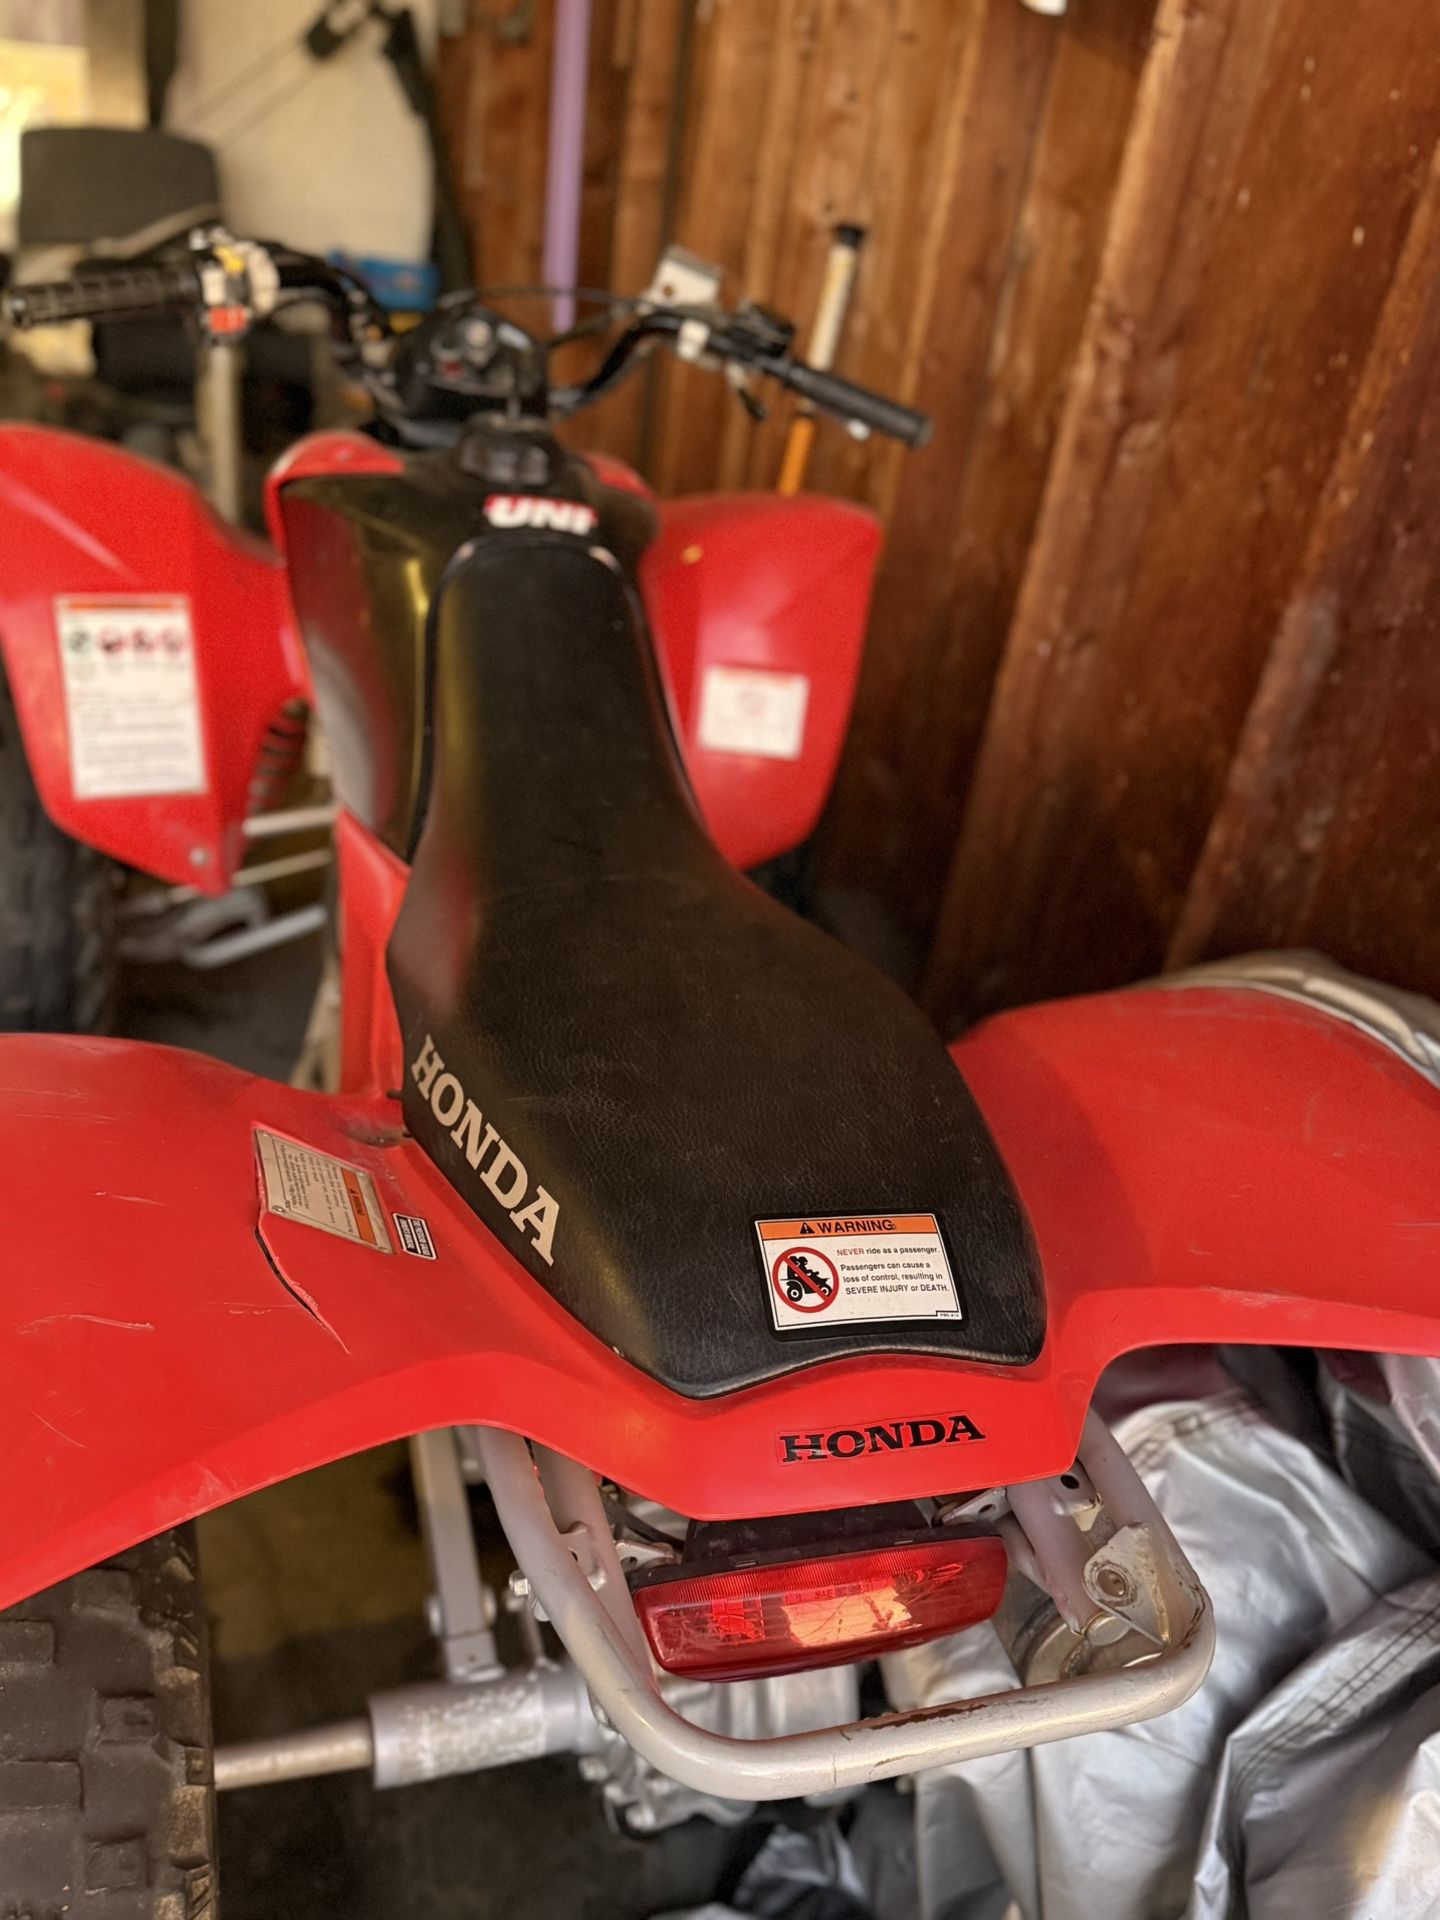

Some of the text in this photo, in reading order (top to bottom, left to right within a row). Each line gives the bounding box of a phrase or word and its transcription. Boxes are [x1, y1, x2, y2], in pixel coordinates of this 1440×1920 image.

[411, 1034, 559, 1266] HONDA
[817, 1219, 893, 1233] WARNING
[837, 1248, 864, 1256] NEVER
[840, 1263, 885, 1271] Passengers
[902, 1273, 934, 1281] resulting
[845, 1286, 878, 1294] SEVERE
[780, 1415, 986, 1463] HONDA
